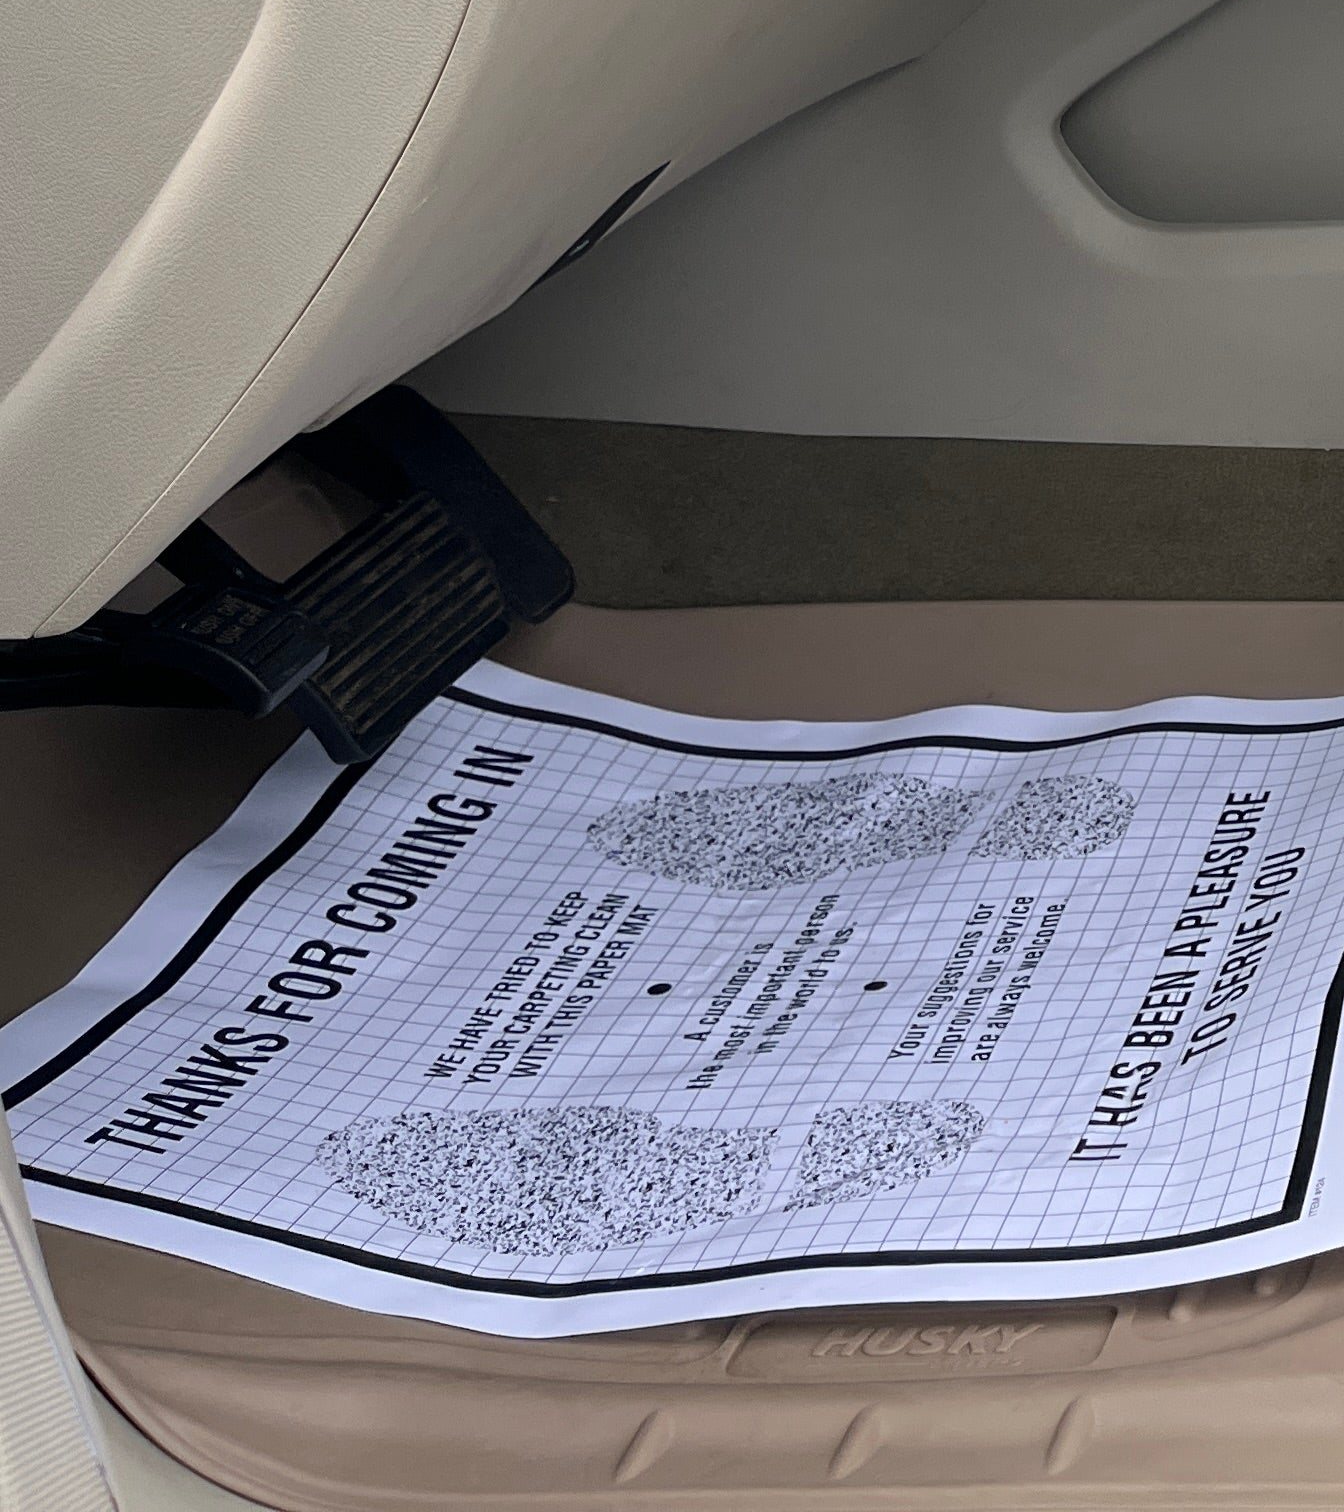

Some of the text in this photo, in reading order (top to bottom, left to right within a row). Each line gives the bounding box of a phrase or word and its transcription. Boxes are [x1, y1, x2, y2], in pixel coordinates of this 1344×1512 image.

[84, 744, 535, 1155] THANKS FOR COMING IN
[424, 891, 589, 1078] WE HAVE TRIED TO KEEP
[462, 893, 629, 1084] YOUR CARPETING CLEAN
[509, 904, 659, 1077] WITH THIS PAPER MAT
[684, 942, 774, 1042] A customer is
[686, 894, 840, 1089] the most important person
[747, 921, 857, 1055] in the world to us.
[887, 903, 996, 1060] Your suggestions for
[923, 897, 1034, 1064] improving our service
[971, 898, 1069, 1062] are always welcome.
[1069, 790, 1271, 1161] IT HAS BEEN A PLEASURE
[1180, 847, 1306, 1066] TO SERVE YOU
[812, 1324, 1045, 1357] HUSKY
